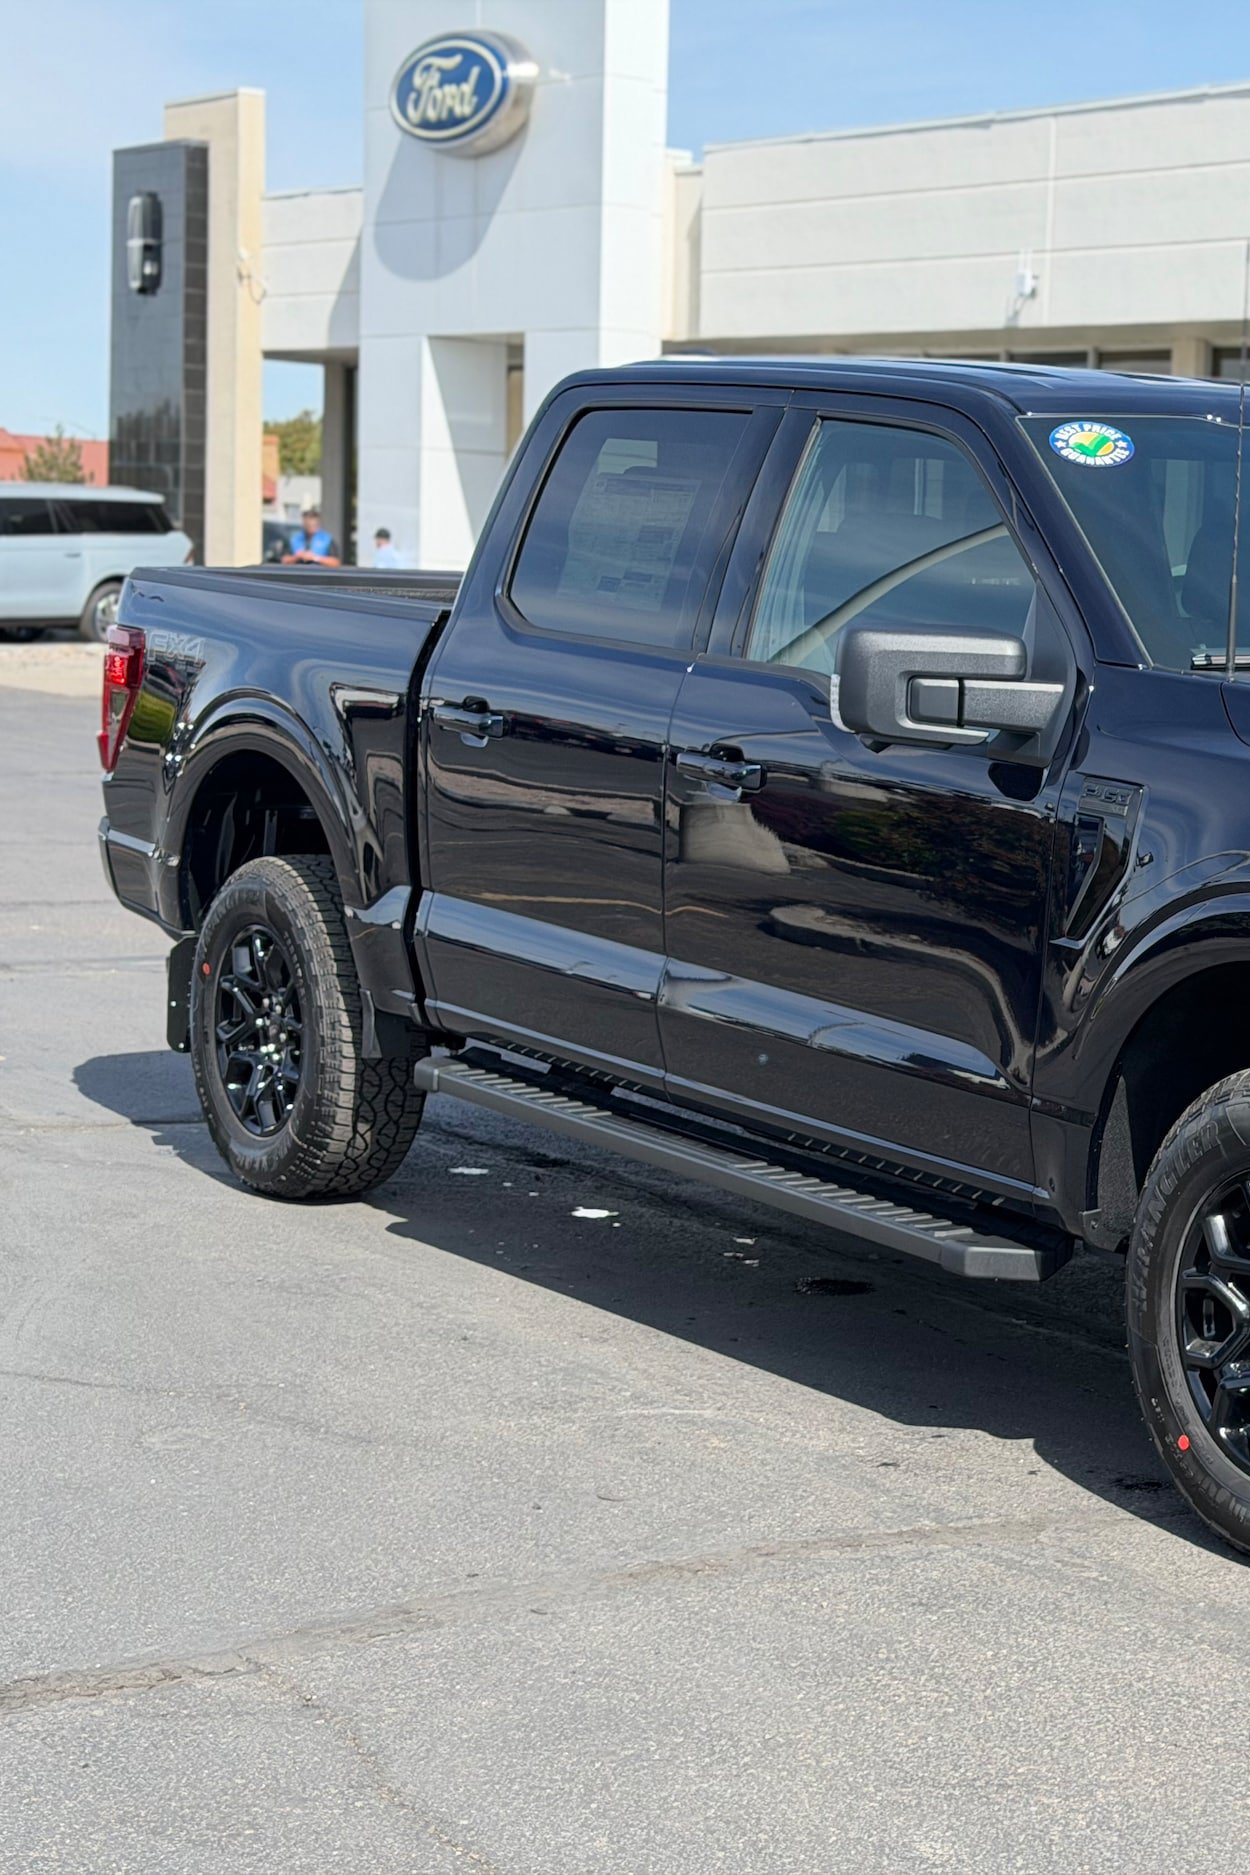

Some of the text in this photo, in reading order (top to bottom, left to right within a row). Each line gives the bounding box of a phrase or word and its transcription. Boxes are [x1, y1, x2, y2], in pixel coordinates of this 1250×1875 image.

[406, 54, 481, 125] Ford
[1054, 423, 1122, 440] BEST PRICE
[147, 630, 205, 666] FX4
